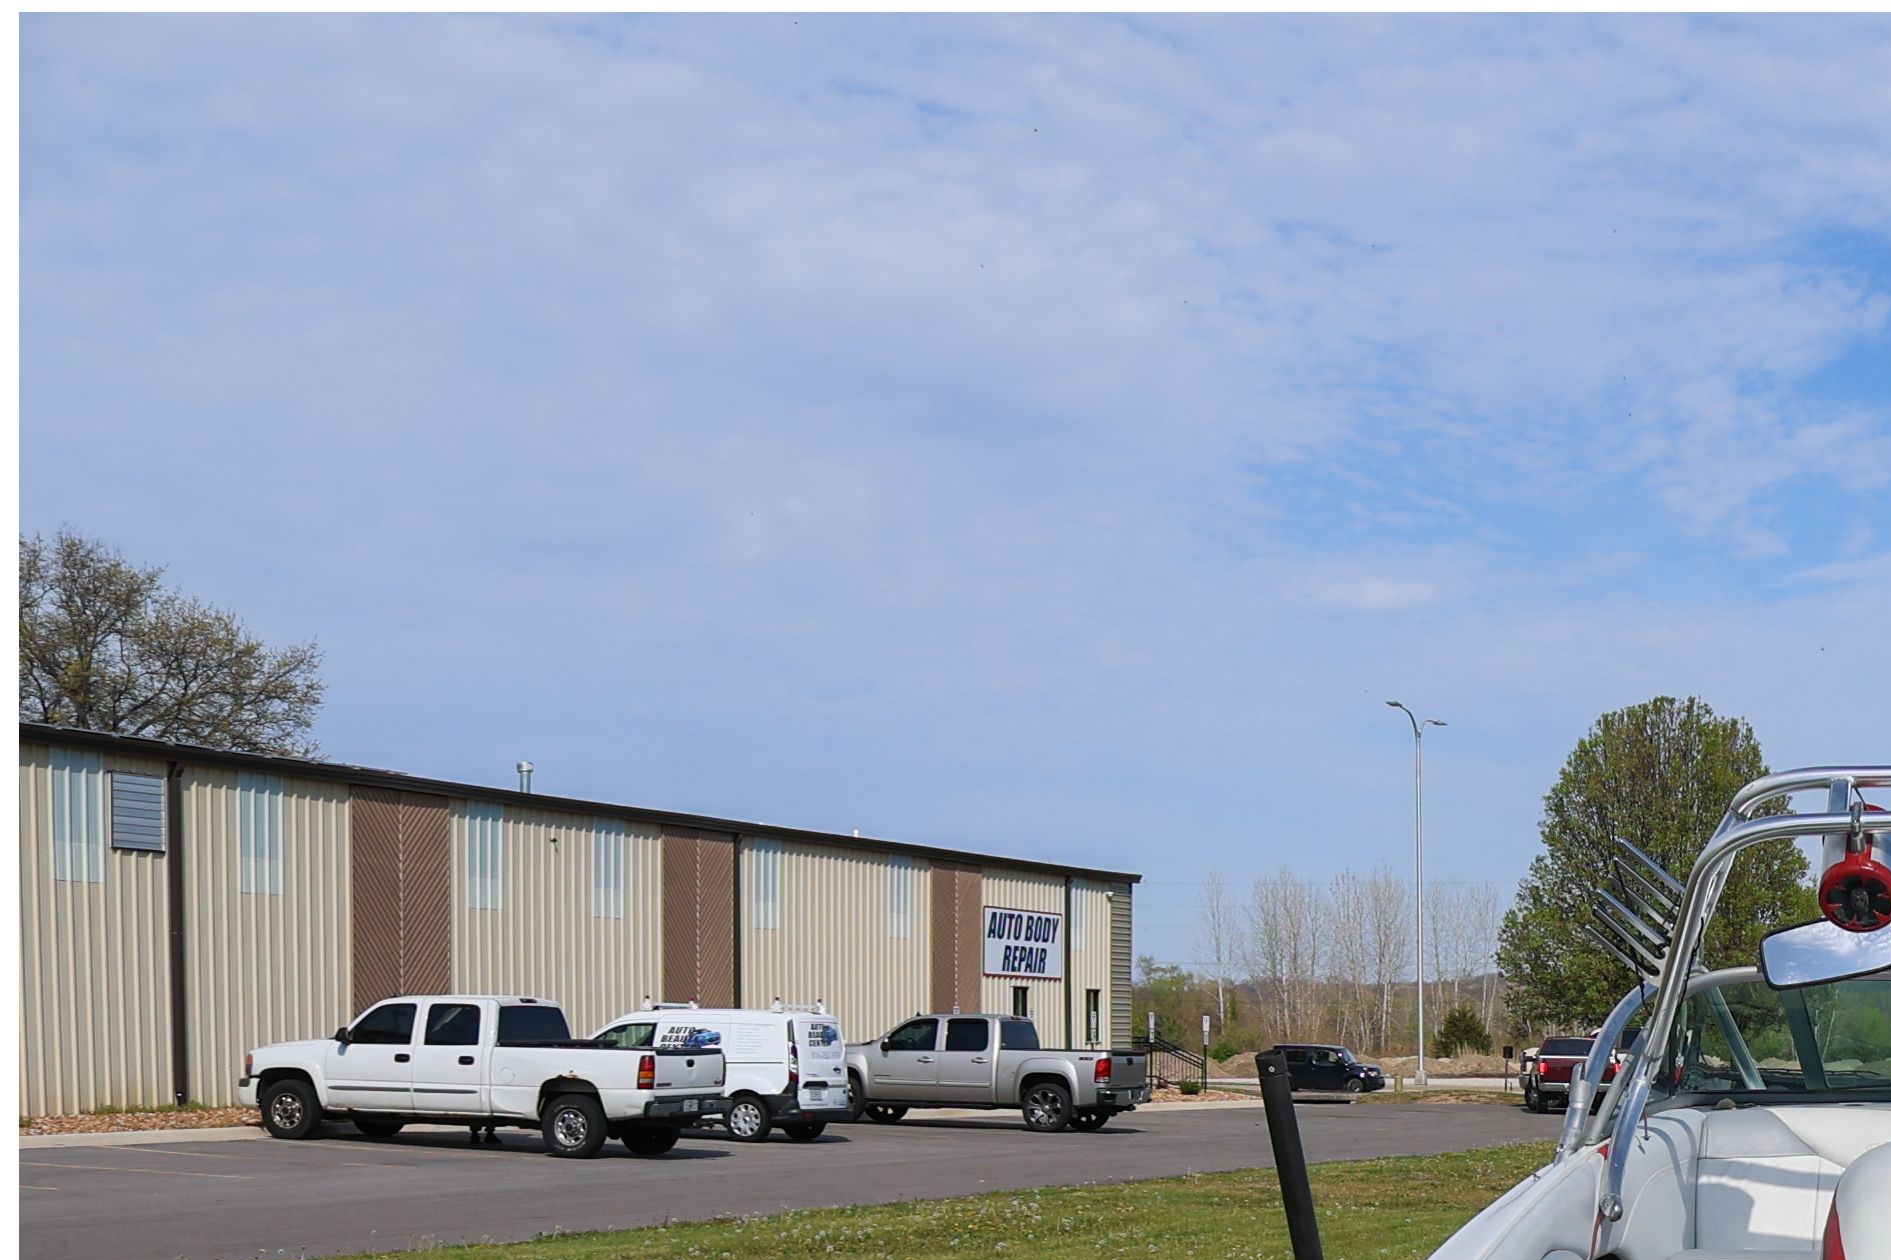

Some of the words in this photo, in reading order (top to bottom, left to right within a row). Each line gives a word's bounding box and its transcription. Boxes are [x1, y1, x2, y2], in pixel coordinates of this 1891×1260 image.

[987, 912, 1023, 941] AUTO
[1024, 915, 1060, 944] BODY
[1001, 945, 1048, 974] REPAIR
